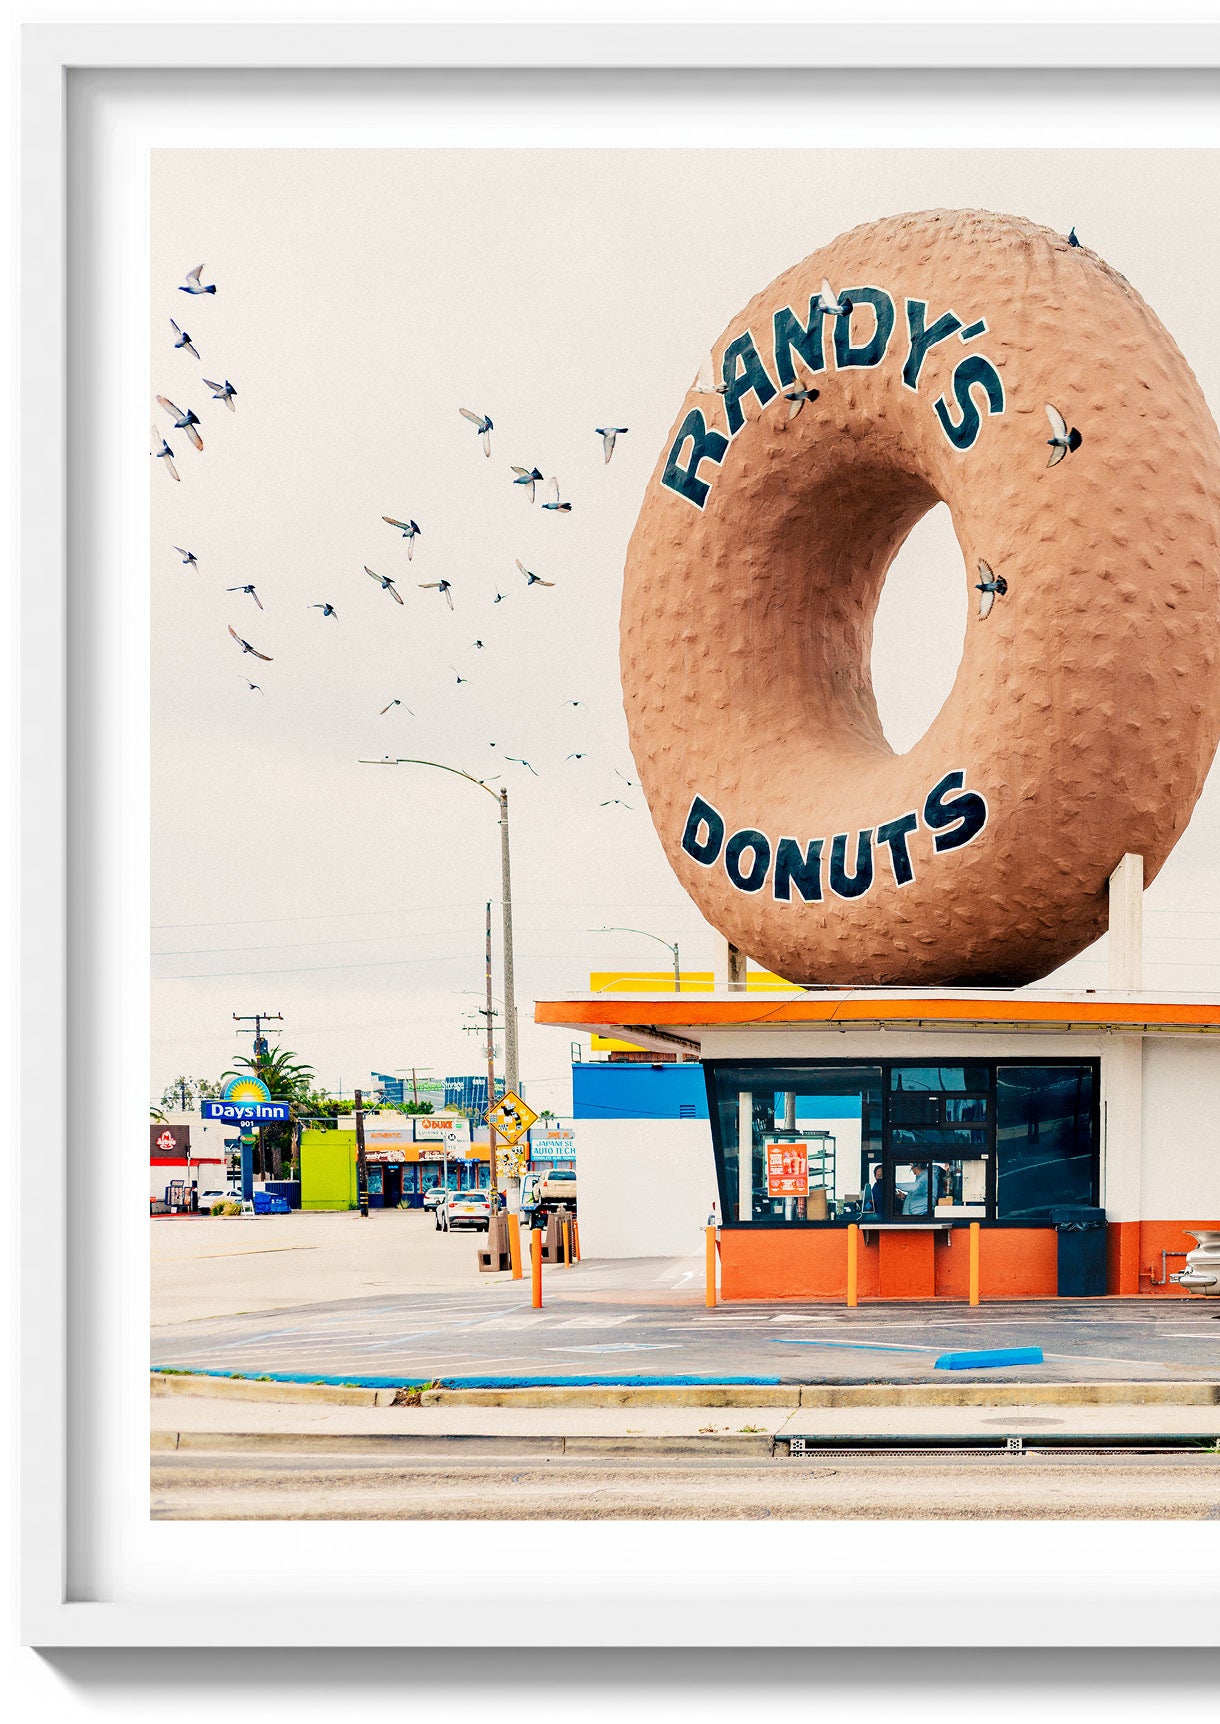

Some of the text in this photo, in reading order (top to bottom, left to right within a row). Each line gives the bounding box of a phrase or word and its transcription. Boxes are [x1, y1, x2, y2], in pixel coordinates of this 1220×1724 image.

[661, 284, 1006, 510] RANDY'S
[680, 768, 989, 904] DONUTS
[211, 1104, 284, 1118] Days Inn
[431, 1121, 452, 1129] DUKE
[534, 1147, 576, 1155] AUTO TECH
